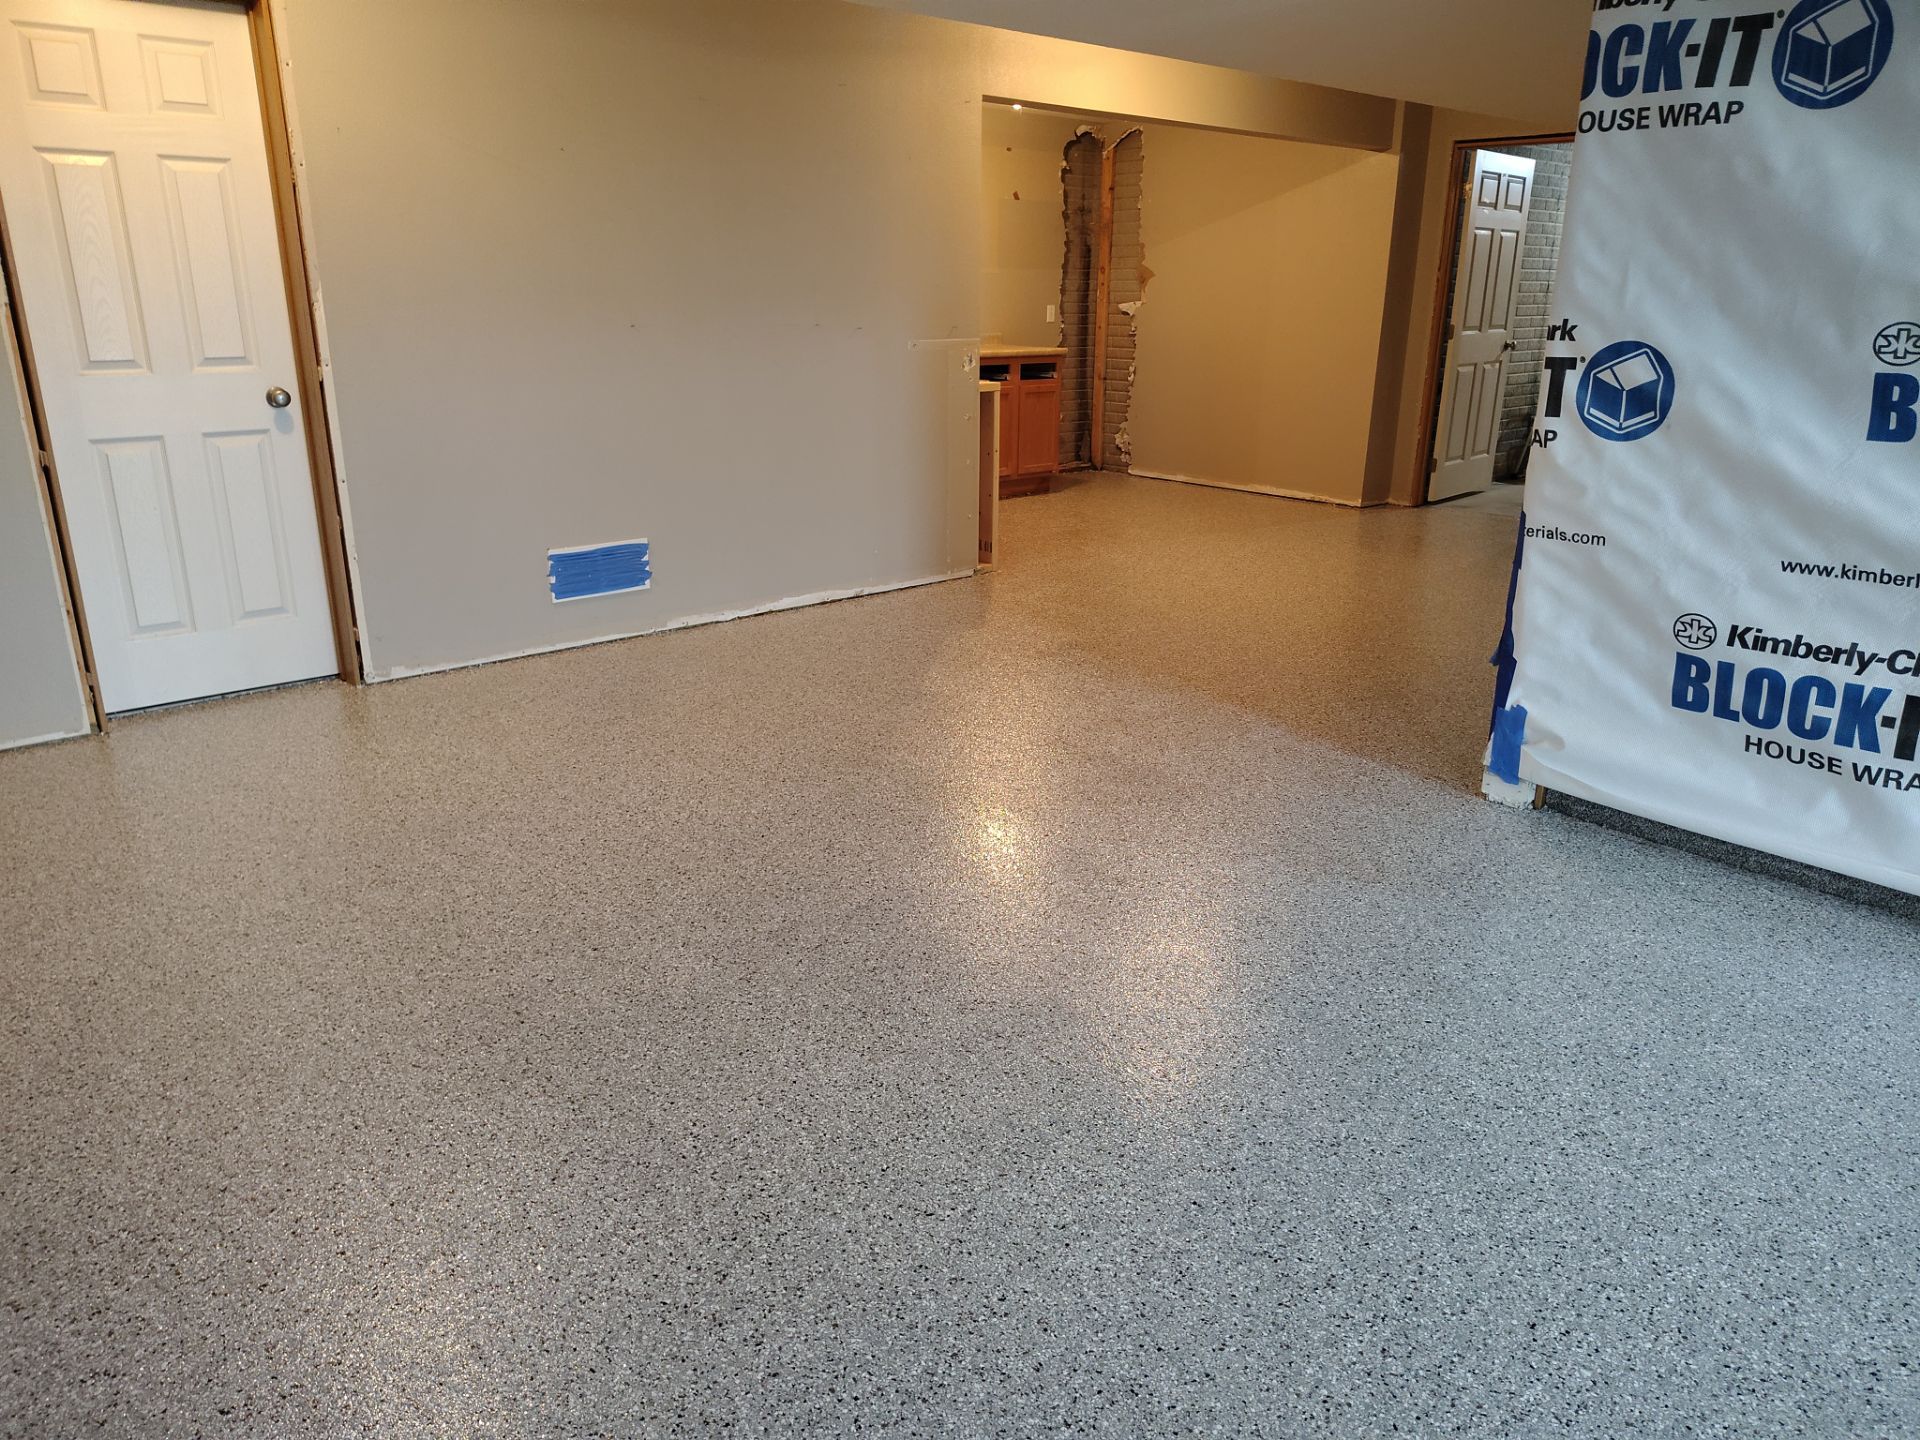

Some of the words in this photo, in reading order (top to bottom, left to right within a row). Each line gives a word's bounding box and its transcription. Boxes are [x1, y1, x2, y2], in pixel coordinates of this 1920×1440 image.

[1578, 106, 1650, 134] OUSE
[1659, 101, 1744, 128] WRAP
[1546, 318, 1577, 341] rk
[1866, 372, 1920, 443] B
[1524, 525, 1606, 547] erials.com
[1780, 559, 1920, 589] www.kimberl
[1744, 734, 1842, 776] HOUSE
